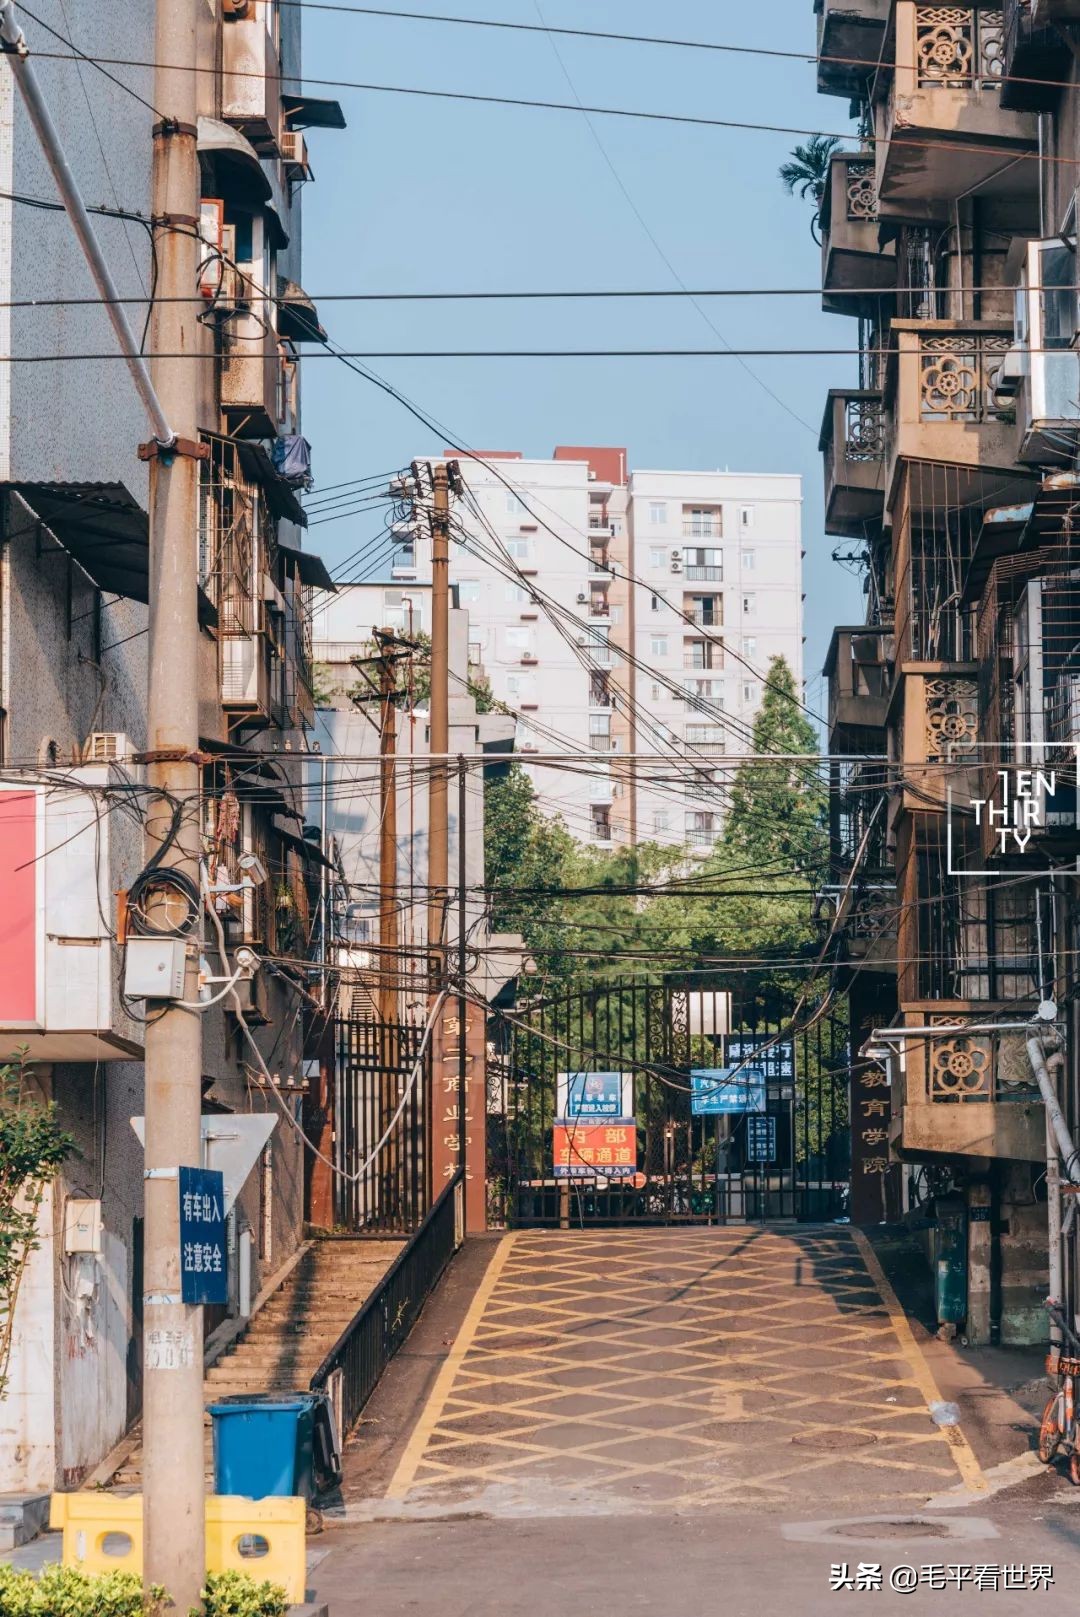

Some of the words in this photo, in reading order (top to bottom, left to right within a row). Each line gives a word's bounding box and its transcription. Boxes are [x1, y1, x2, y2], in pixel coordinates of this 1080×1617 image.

[860, 1013, 890, 1174] 继教育学院
[565, 1128, 627, 1144] 内部
[560, 1147, 632, 1163] 车辆通道
[183, 1191, 221, 1223] 有车出入
[183, 1242, 222, 1272] 注意安全
